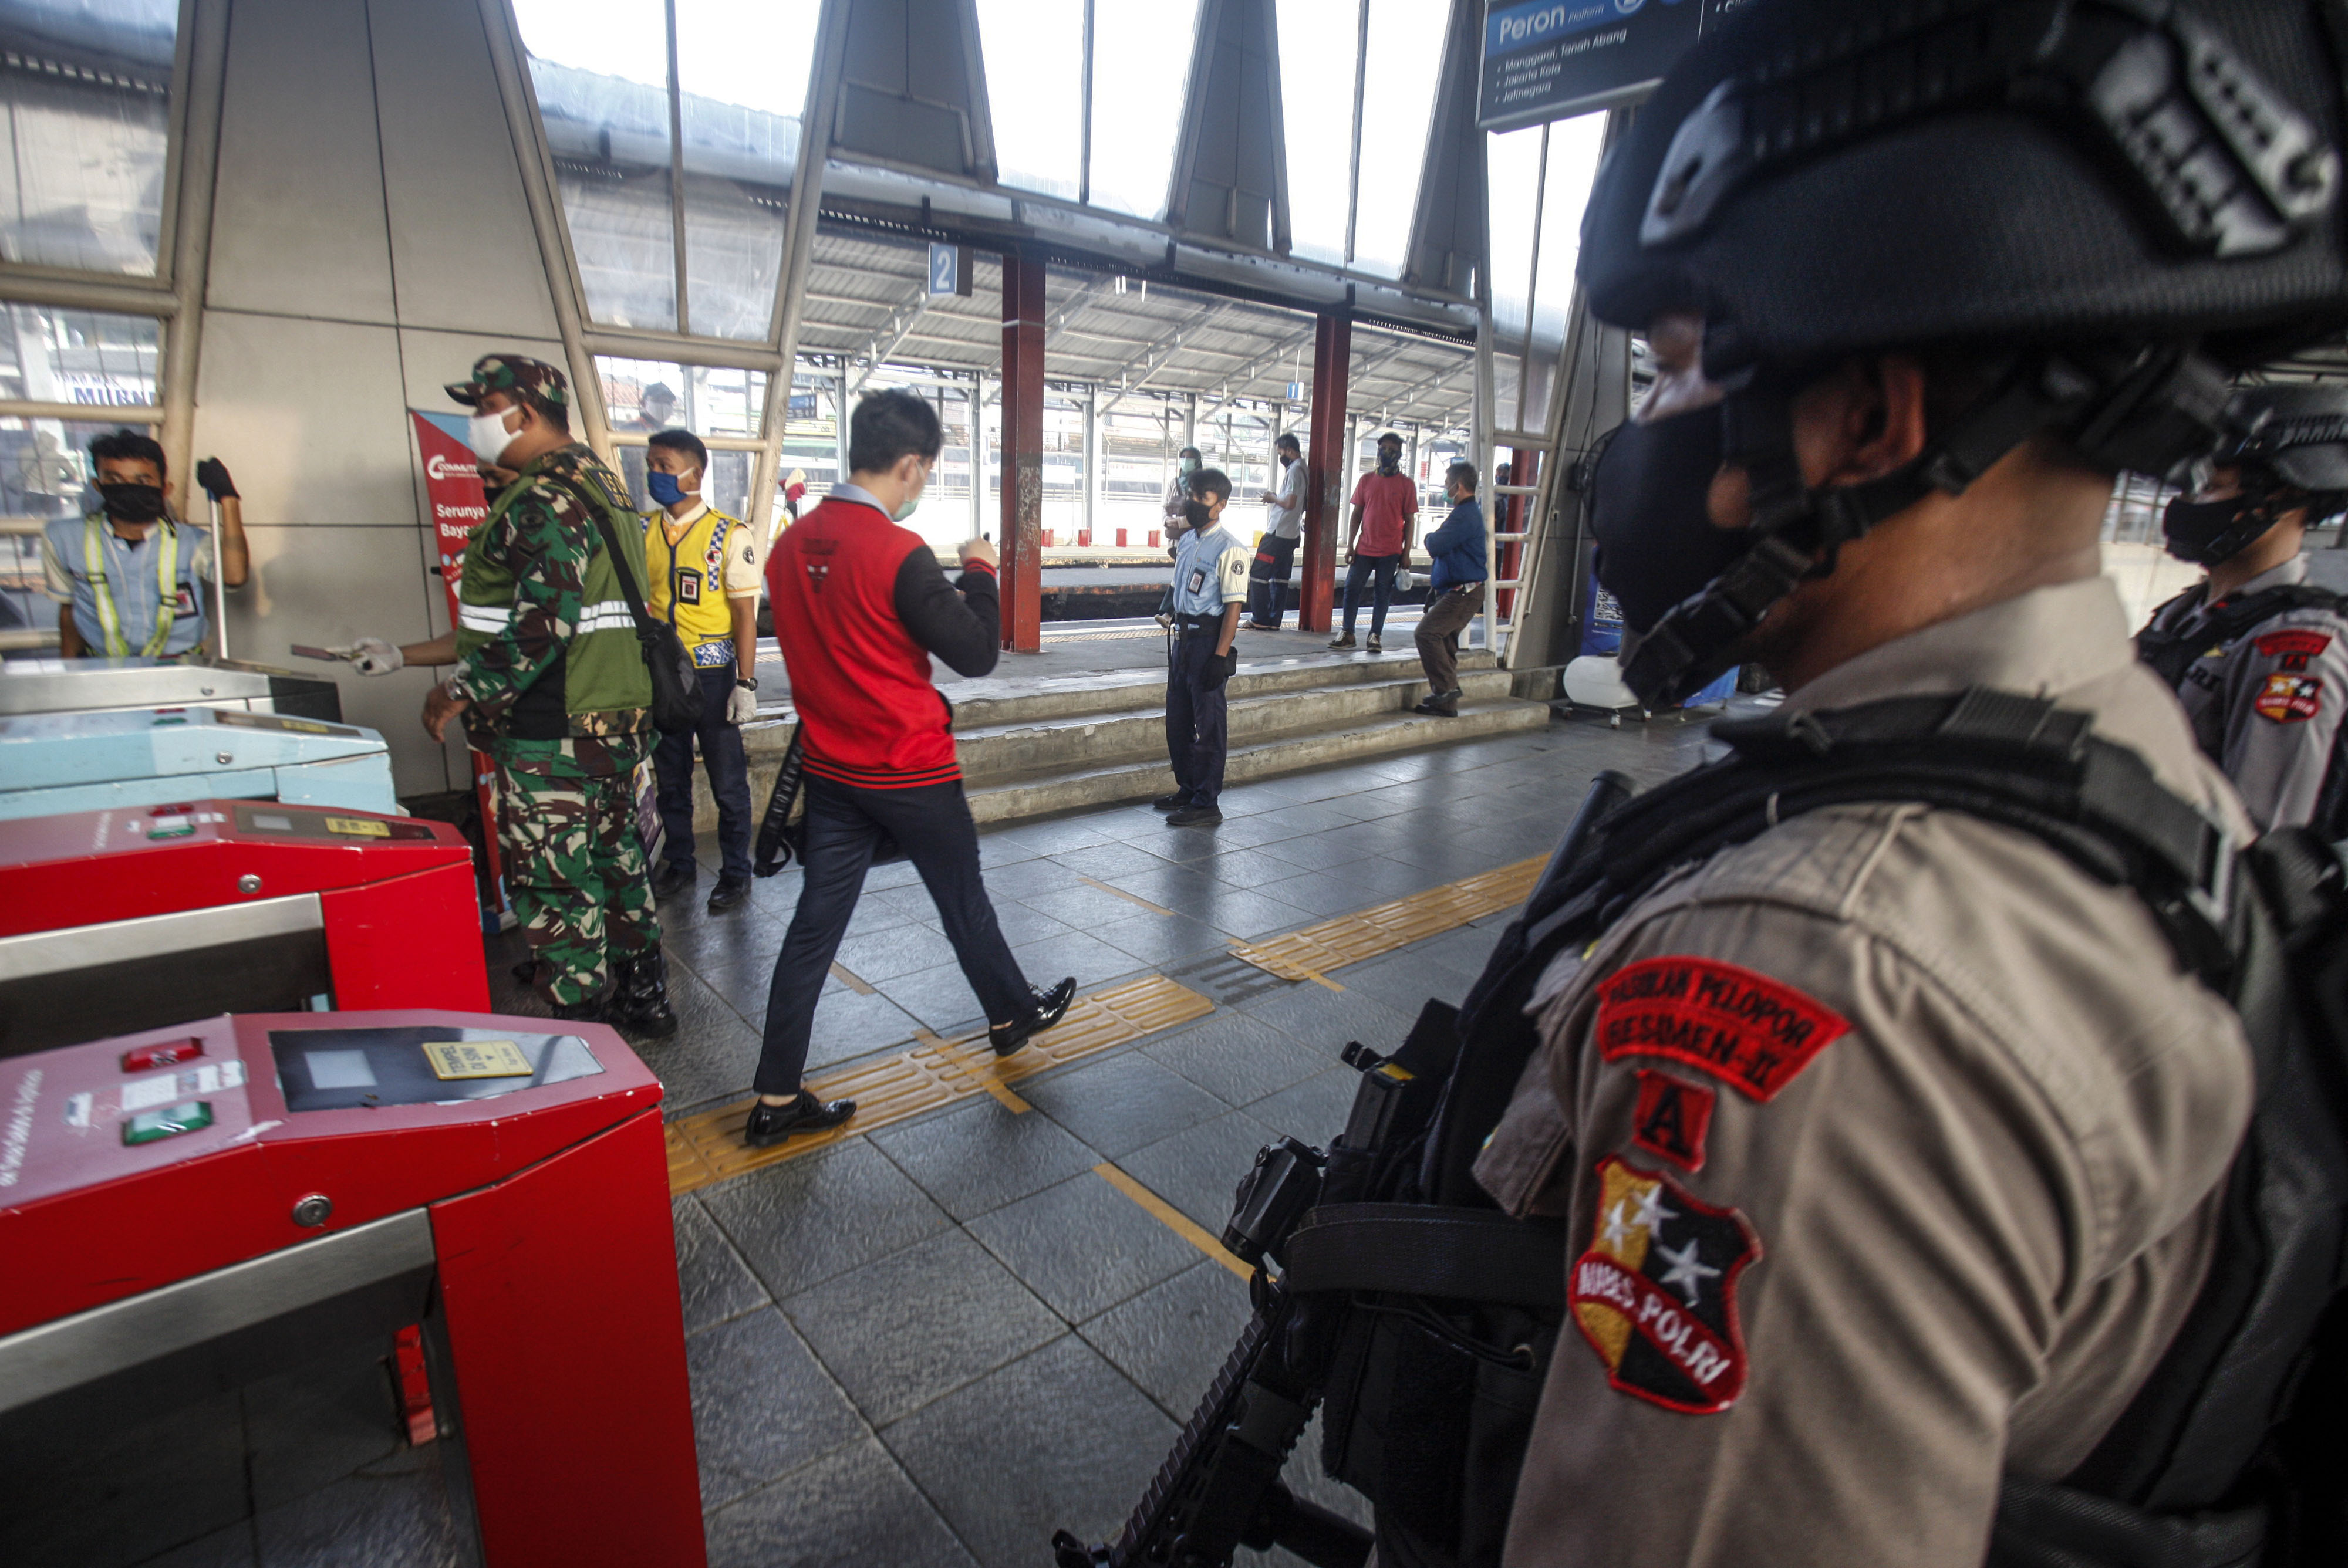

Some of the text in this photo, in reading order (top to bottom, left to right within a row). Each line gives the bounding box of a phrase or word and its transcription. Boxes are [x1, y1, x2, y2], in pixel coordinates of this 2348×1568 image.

[1499, 5, 1565, 45] Peron
[1561, 38, 1590, 58] Tanah
[1591, 28, 1627, 49] Abang
[1504, 62, 1561, 89] Jakarta Kota
[936, 250, 951, 290] 2
[1291, 384, 1296, 398] 1
[436, 503, 485, 520] Serunya
[1642, 1086, 1692, 1156] A
[1638, 1292, 1732, 1385] POLRI
